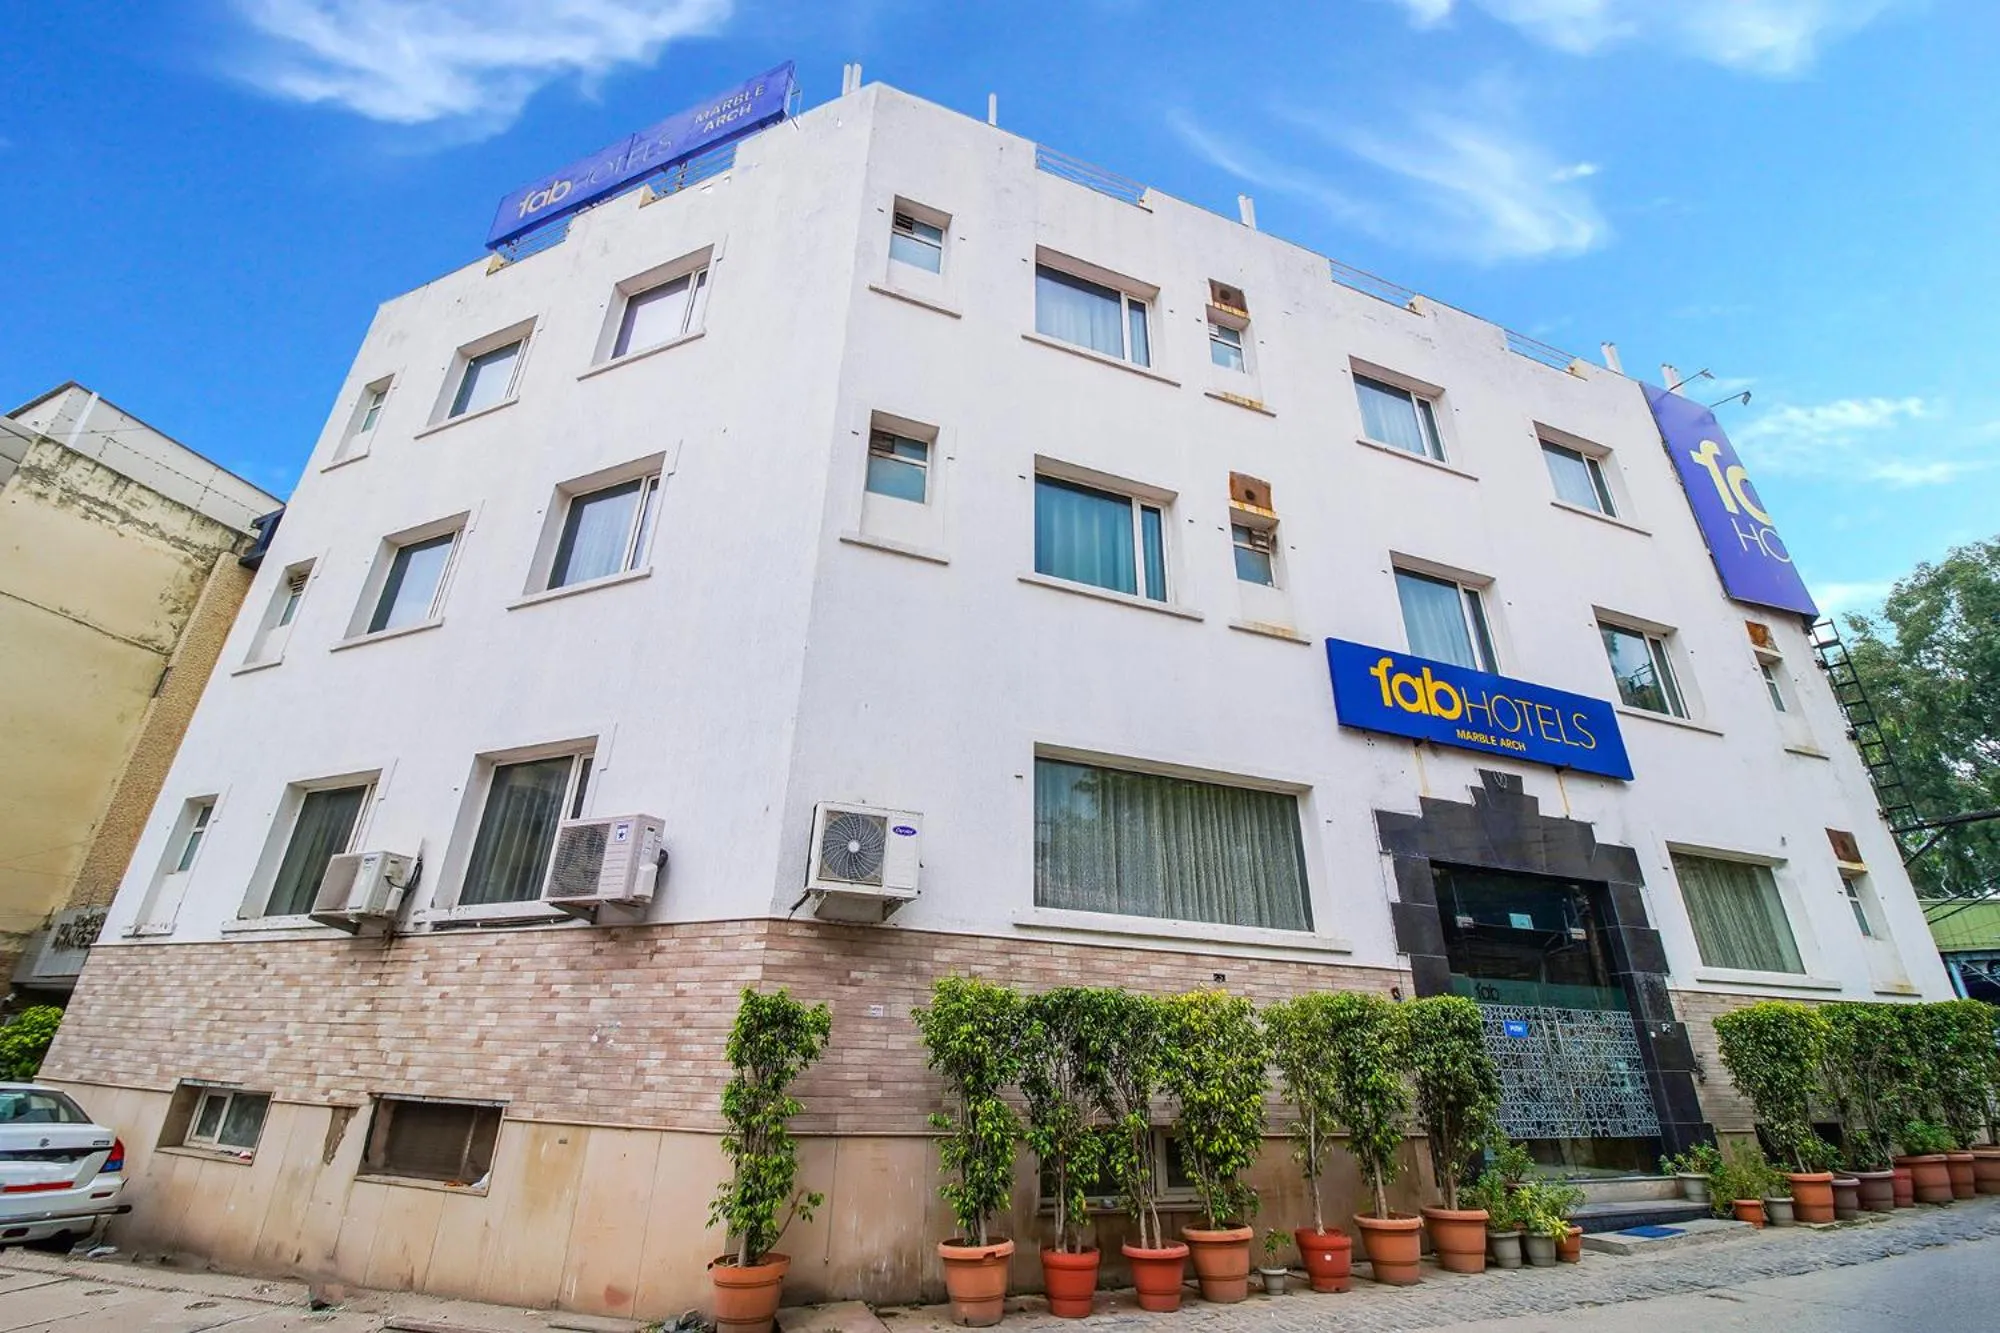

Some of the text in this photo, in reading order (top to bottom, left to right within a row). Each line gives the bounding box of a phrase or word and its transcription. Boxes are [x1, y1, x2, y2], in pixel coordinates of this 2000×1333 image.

[696, 84, 765, 124] MARBLE
[703, 102, 752, 134] ARCH
[1456, 728, 1527, 752] MARBLE ARCH
